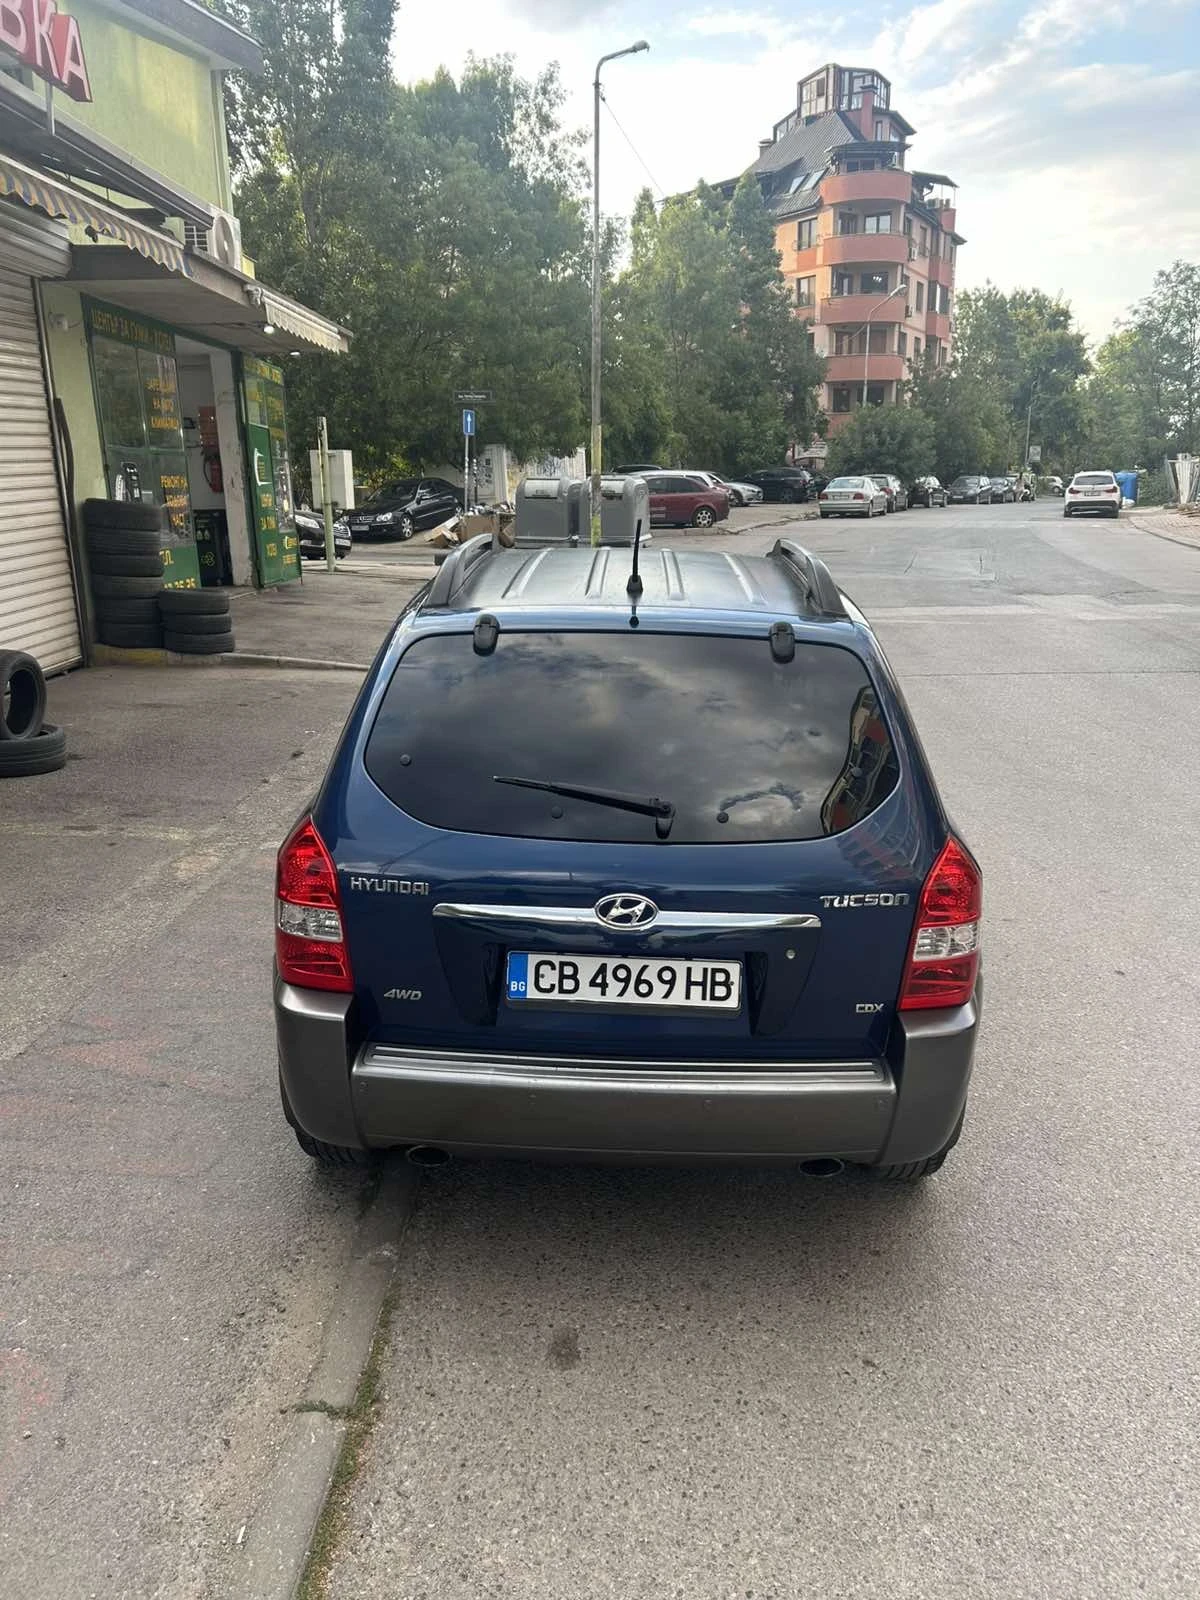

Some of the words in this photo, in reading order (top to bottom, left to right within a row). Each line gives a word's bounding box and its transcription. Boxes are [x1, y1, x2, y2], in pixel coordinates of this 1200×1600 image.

[350, 876, 430, 896] HYUNDAI
[819, 892, 911, 909] TUCSON
[510, 980, 526, 992] BG
[533, 959, 580, 994] CB
[588, 962, 677, 1000] 4969
[685, 966, 733, 1002] HB
[383, 988, 423, 1001] 4WD
